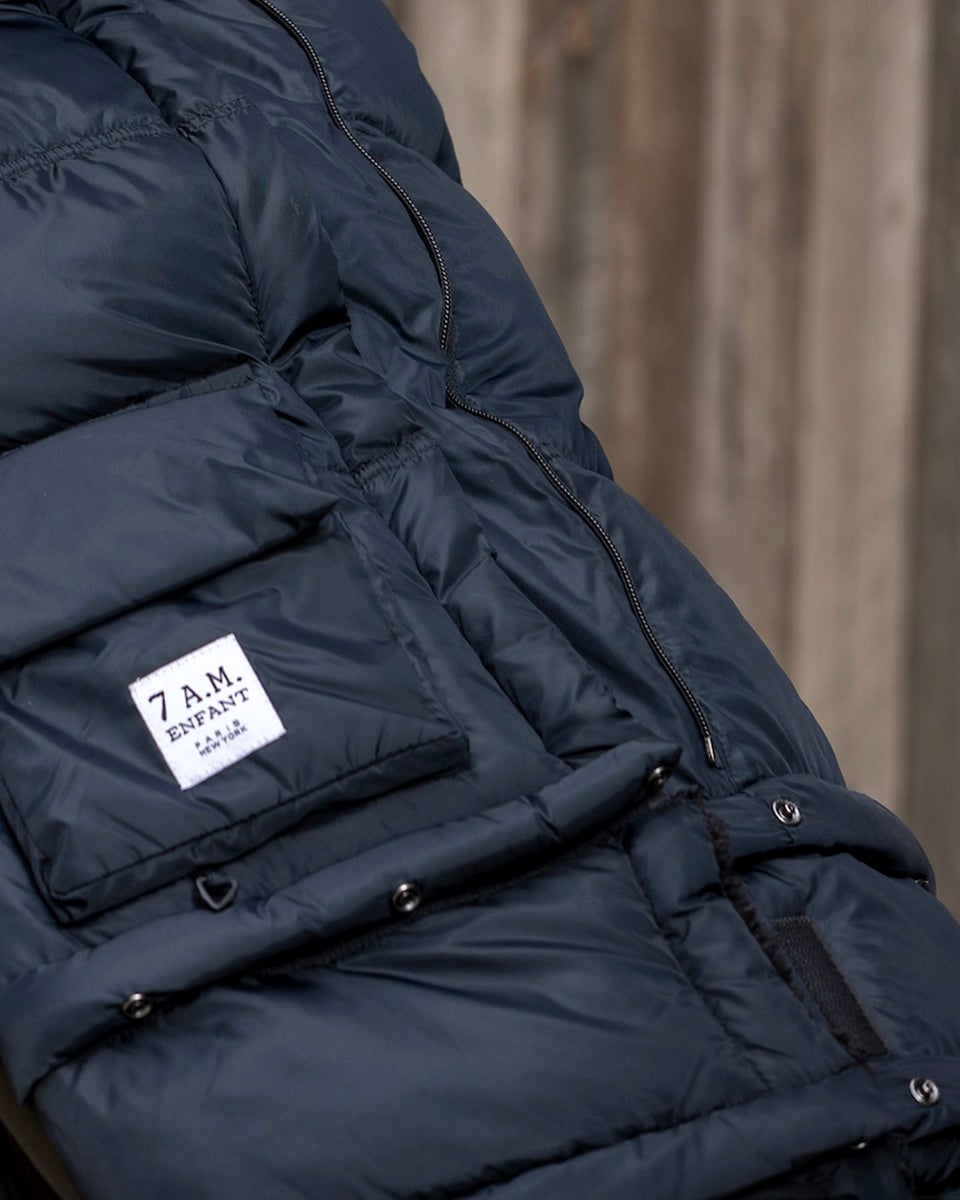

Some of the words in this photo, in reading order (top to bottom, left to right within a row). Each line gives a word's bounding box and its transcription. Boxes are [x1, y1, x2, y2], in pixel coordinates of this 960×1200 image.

[148, 690, 167, 722] 7
[181, 666, 243, 709] A.M.
[166, 687, 249, 742] ENFANT
